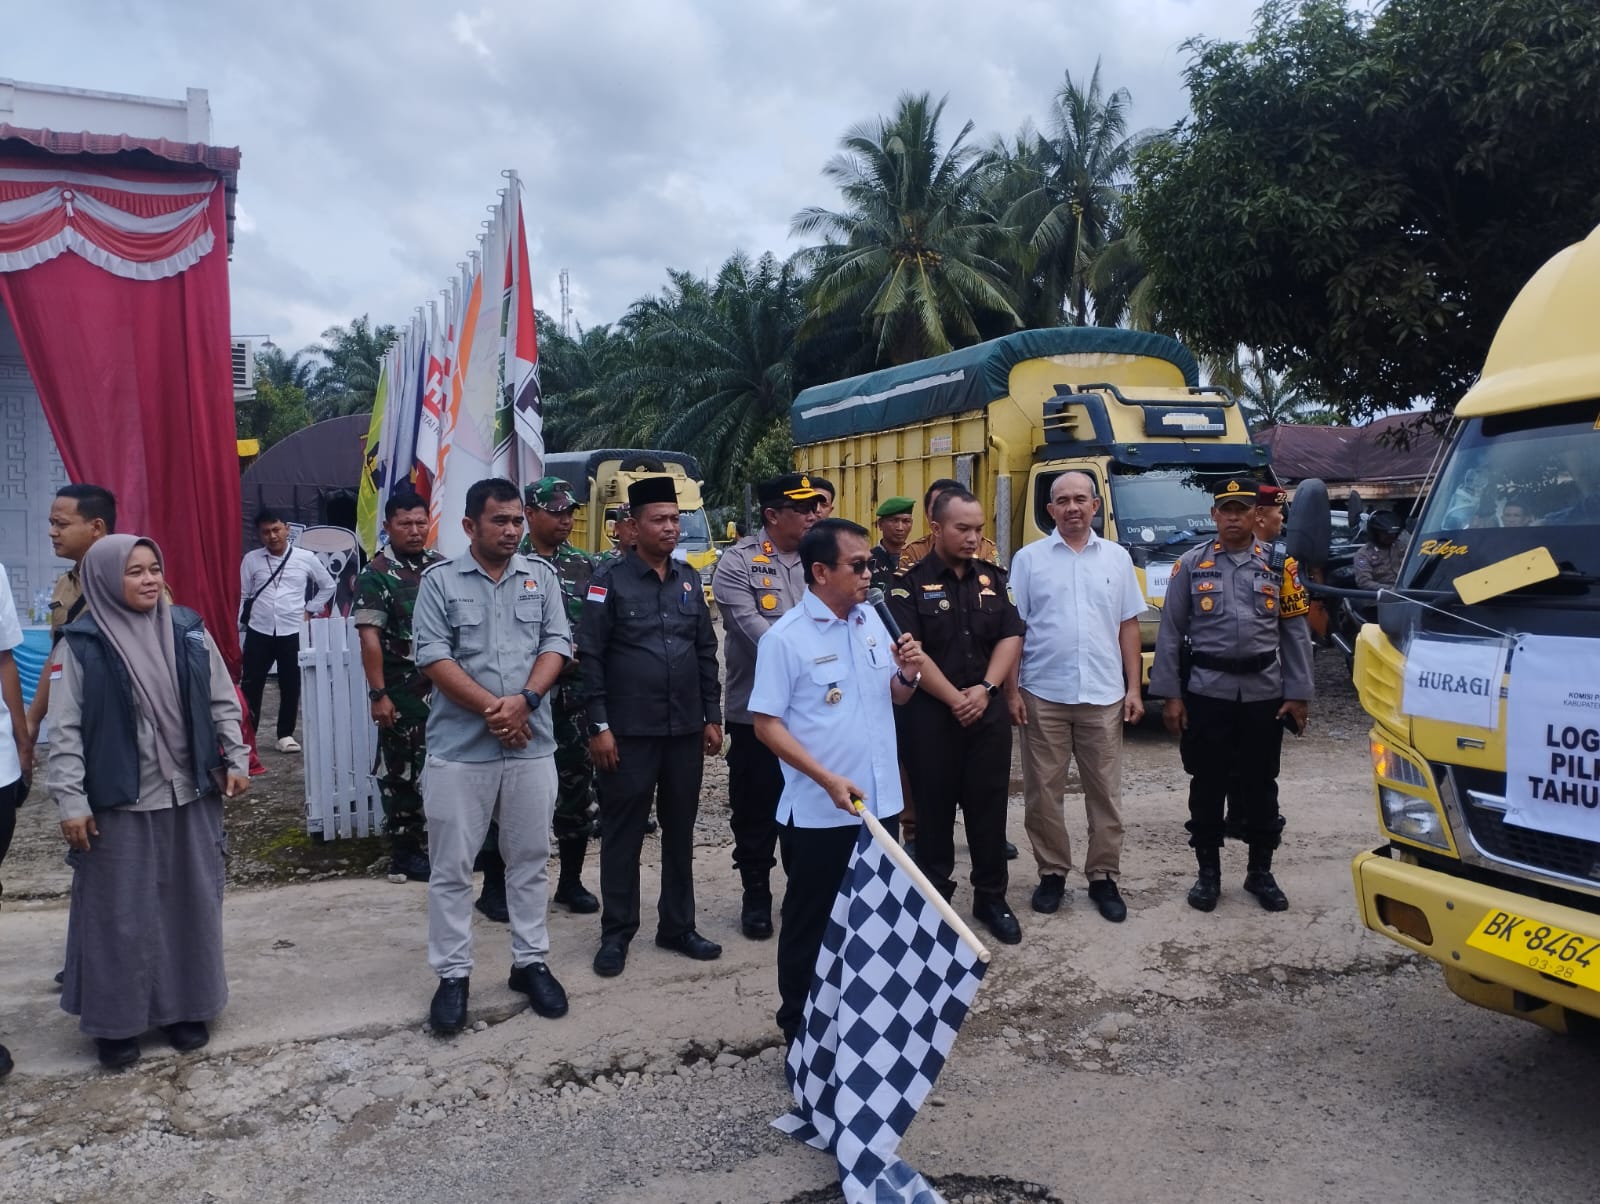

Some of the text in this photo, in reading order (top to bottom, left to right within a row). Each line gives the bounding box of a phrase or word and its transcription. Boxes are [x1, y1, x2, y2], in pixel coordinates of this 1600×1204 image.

[1418, 671, 1491, 697] HURAGI
[1568, 692, 1594, 700] KOMISI
[1563, 700, 1600, 710] KABUPATE
[1546, 724, 1600, 752] LOG
[1483, 912, 1600, 968] BK 8464
